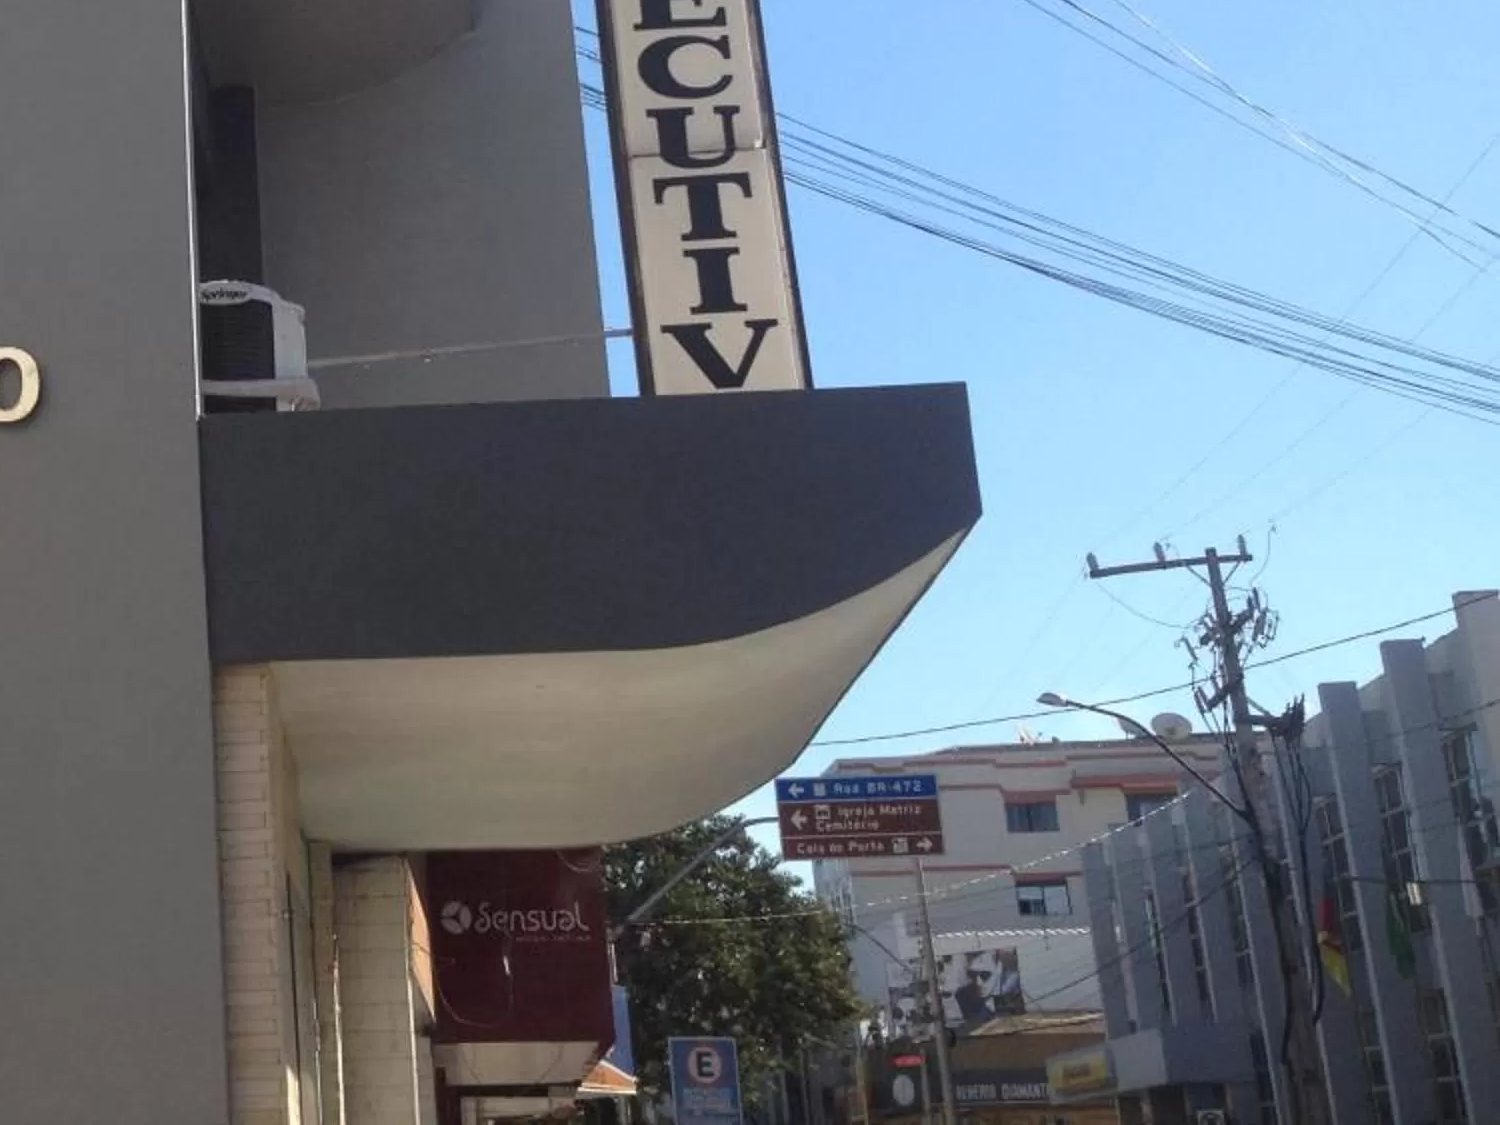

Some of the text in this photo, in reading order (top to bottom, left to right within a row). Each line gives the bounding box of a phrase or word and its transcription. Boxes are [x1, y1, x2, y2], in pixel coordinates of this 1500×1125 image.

[880, 803, 922, 816] Matriz
[474, 900, 591, 933] Sensual
[696, 1052, 715, 1077] E
